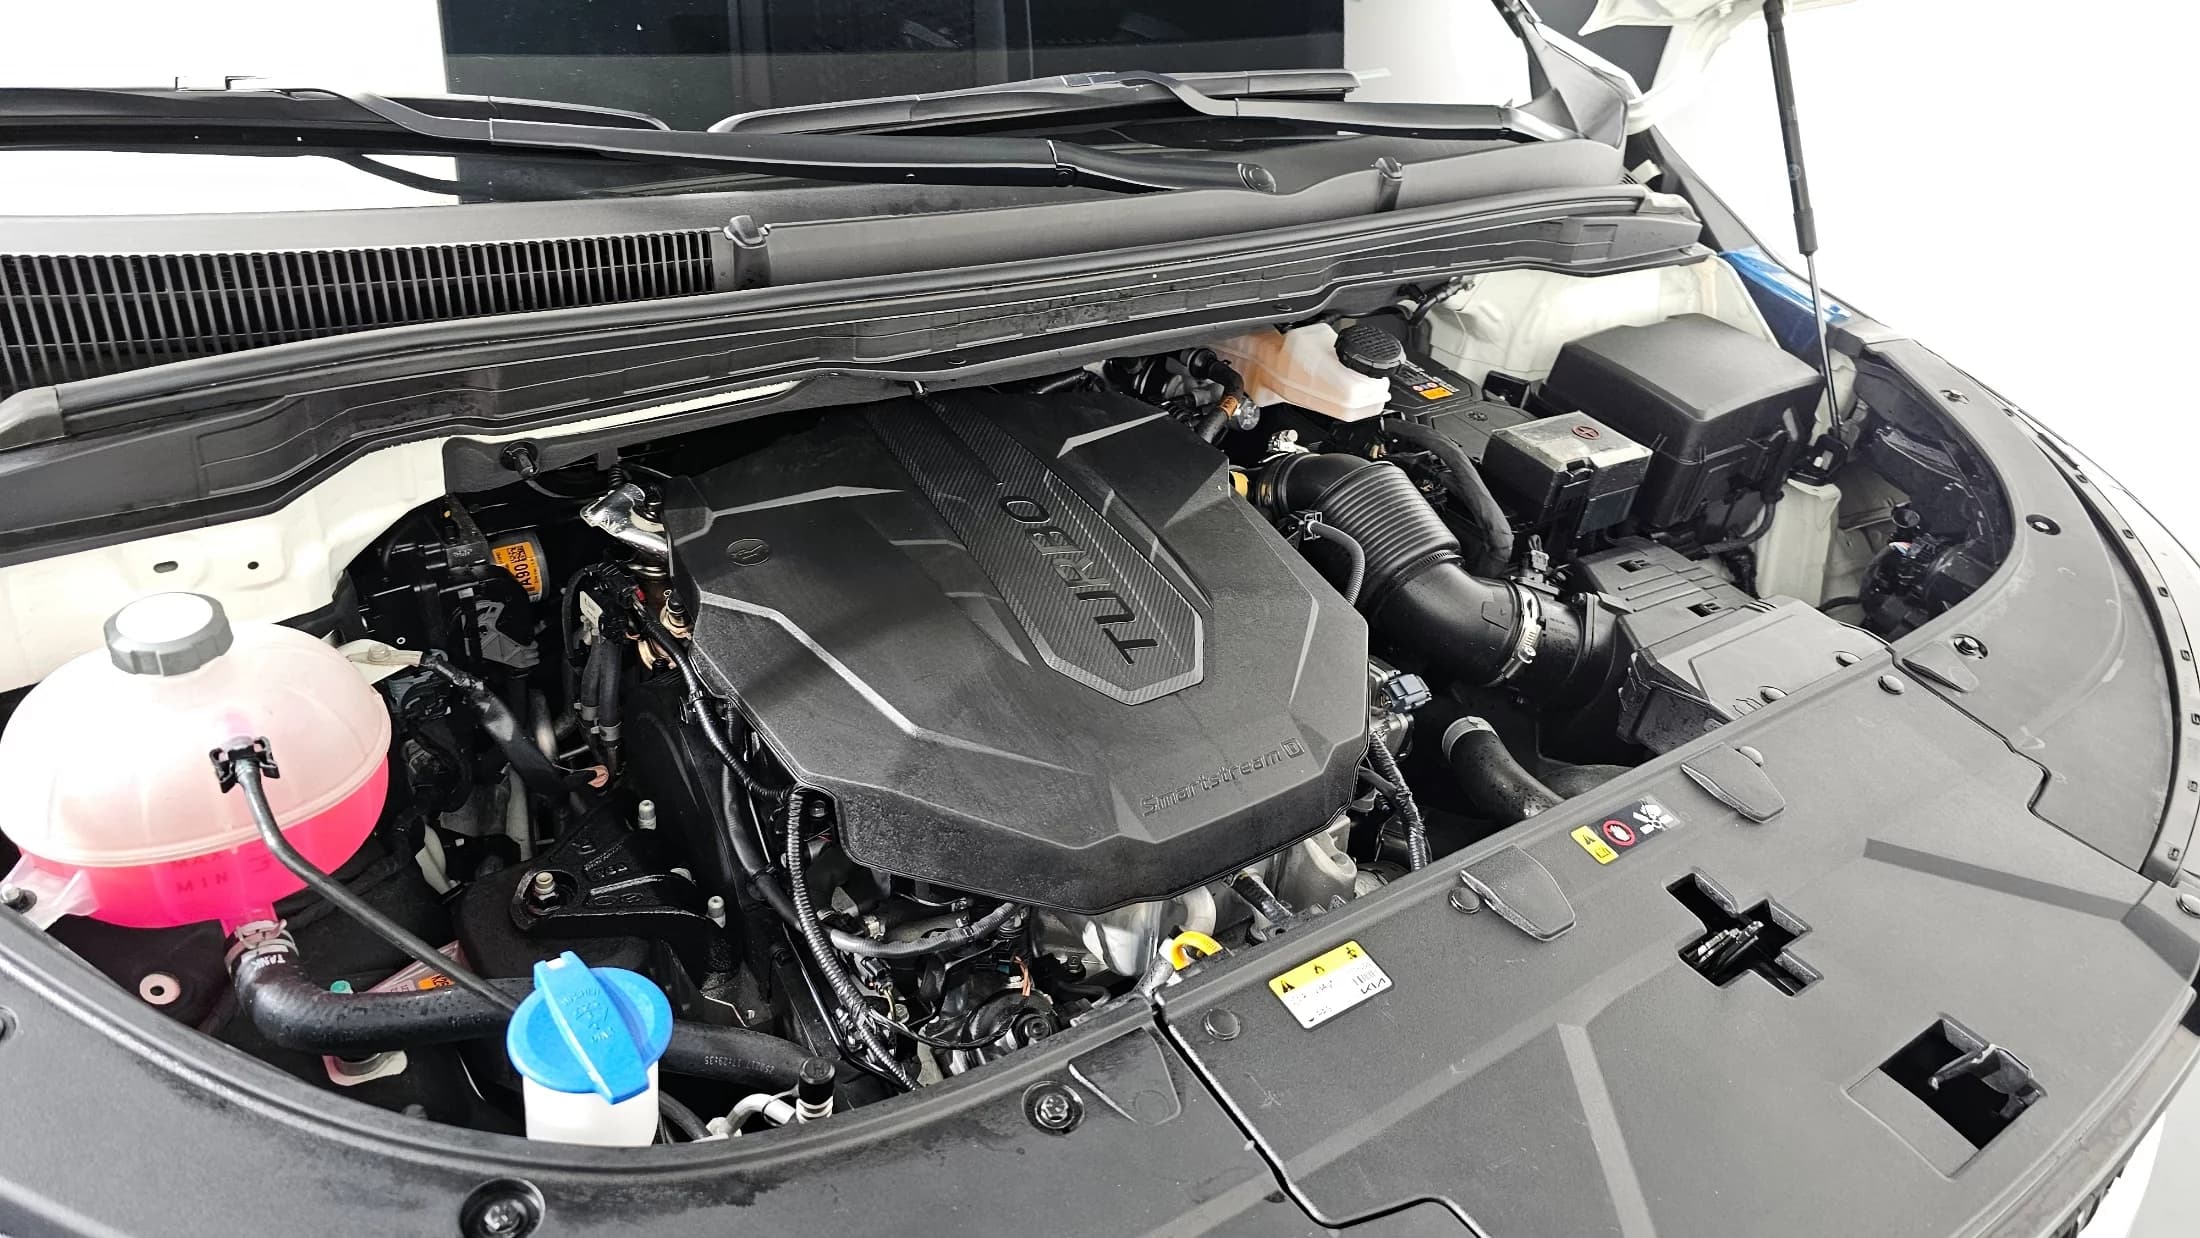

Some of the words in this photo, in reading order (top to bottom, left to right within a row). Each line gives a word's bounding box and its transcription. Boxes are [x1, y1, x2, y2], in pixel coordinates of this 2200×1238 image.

[1001, 496, 1158, 665] TURBO
[1140, 748, 1282, 817] Smartstream
[176, 871, 228, 893] MIN
